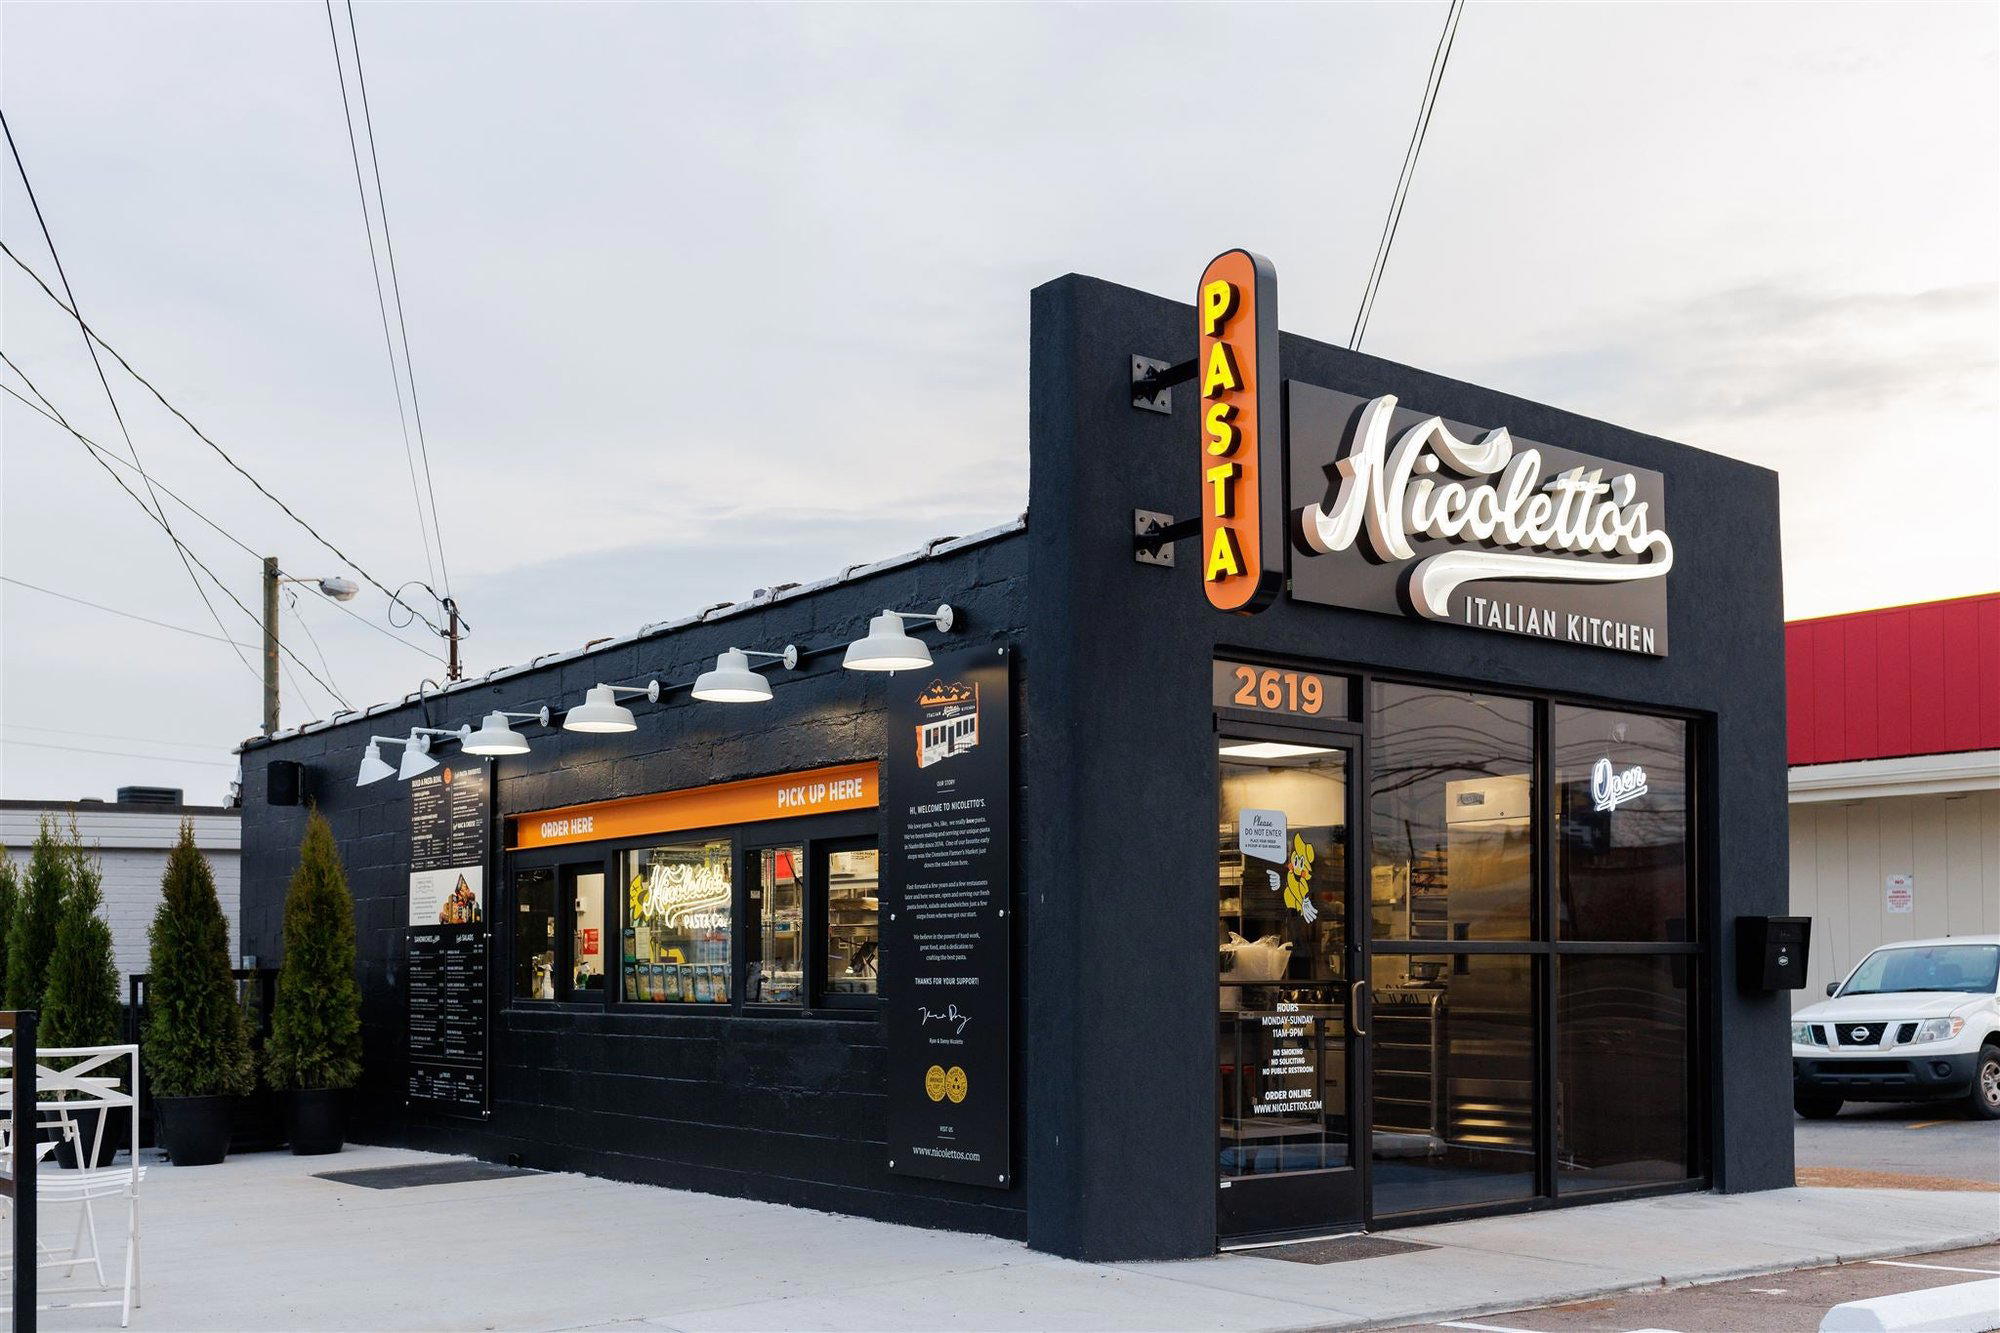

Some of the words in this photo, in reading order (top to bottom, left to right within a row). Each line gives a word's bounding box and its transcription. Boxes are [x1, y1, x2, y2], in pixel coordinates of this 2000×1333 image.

[1203, 278, 1245, 583] PASTA
[1302, 393, 1673, 618] Nicoletto's
[1464, 595, 1557, 638] ITALIAN
[1566, 614, 1656, 655] KITCHEN
[1234, 666, 1325, 715] 2619
[1591, 757, 1648, 812] Open
[778, 787, 805, 808] PICK
[809, 783, 825, 802] UP
[829, 778, 863, 799] HERE
[918, 804, 942, 813] WELCOME
[541, 820, 568, 838] ORDER
[571, 816, 593, 834] HERE
[1252, 814, 1272, 827] Please
[1266, 829, 1281, 837] ENTER
[1277, 1003, 1299, 1012] HOURS
[1262, 1015, 1313, 1025] MONDAY-SUNDAY
[1273, 1028, 1303, 1037] 11AM-9PM
[1279, 1057, 1305, 1065] SOLICITING
[1265, 1091, 1287, 1100] ORDER
[1289, 1089, 1311, 1099] ONLINE
[1253, 1100, 1323, 1114] WWW.NICOLETTOS.COM
[913, 1147, 980, 1161] www.nicolettos.com
